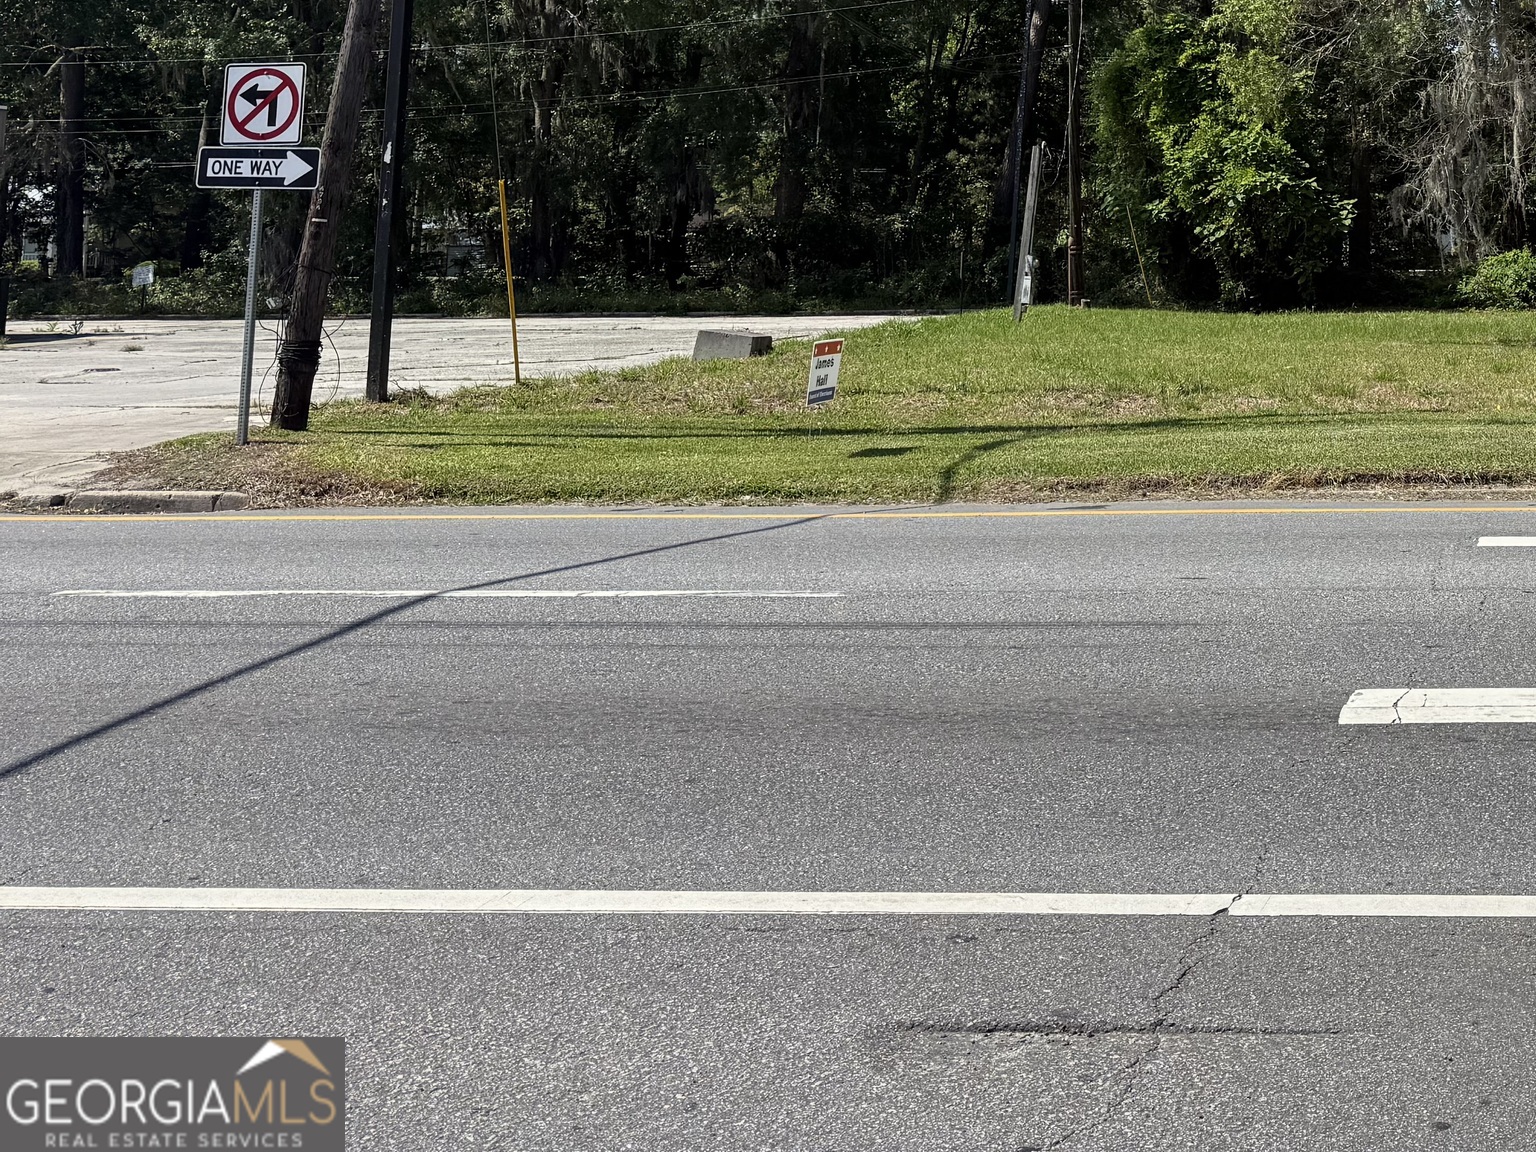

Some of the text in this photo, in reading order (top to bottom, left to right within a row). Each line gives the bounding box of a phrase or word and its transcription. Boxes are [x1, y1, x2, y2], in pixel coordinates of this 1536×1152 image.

[211, 159, 284, 176] ONE WAY
[815, 358, 834, 369] James
[816, 374, 828, 387] Hall
